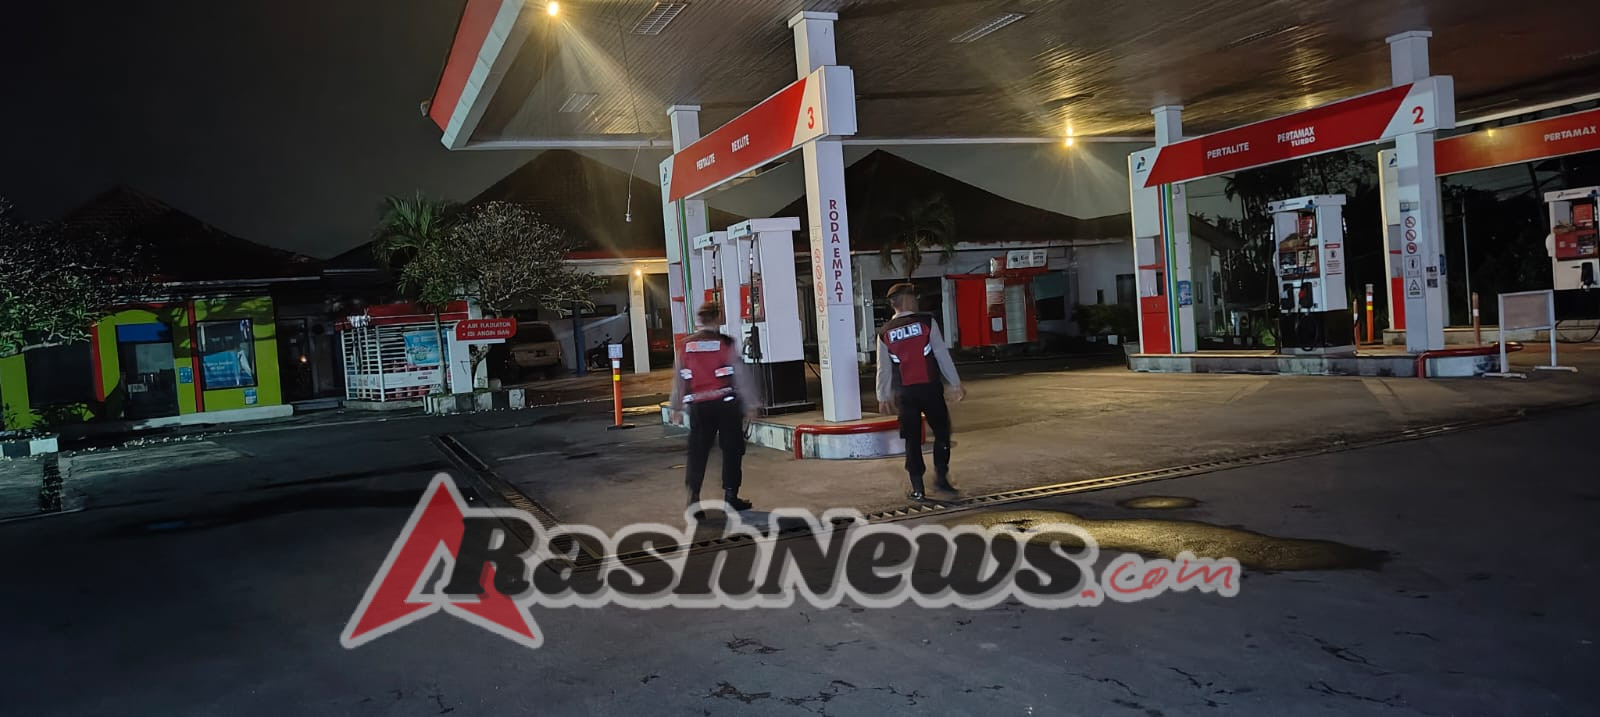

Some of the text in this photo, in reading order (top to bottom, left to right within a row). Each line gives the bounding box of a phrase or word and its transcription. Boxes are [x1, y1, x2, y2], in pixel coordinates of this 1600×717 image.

[807, 106, 815, 130] 3
[1411, 105, 1425, 125] 2
[730, 133, 750, 153] DEXLITE
[1277, 125, 1315, 144] PERTAMAX
[1290, 135, 1316, 147] TURBO
[1543, 125, 1596, 143] PERTAMAX
[1206, 140, 1250, 160] PERTALITE
[829, 199, 844, 303] RODA EMPAT
[480, 321, 511, 329] RADIATOR
